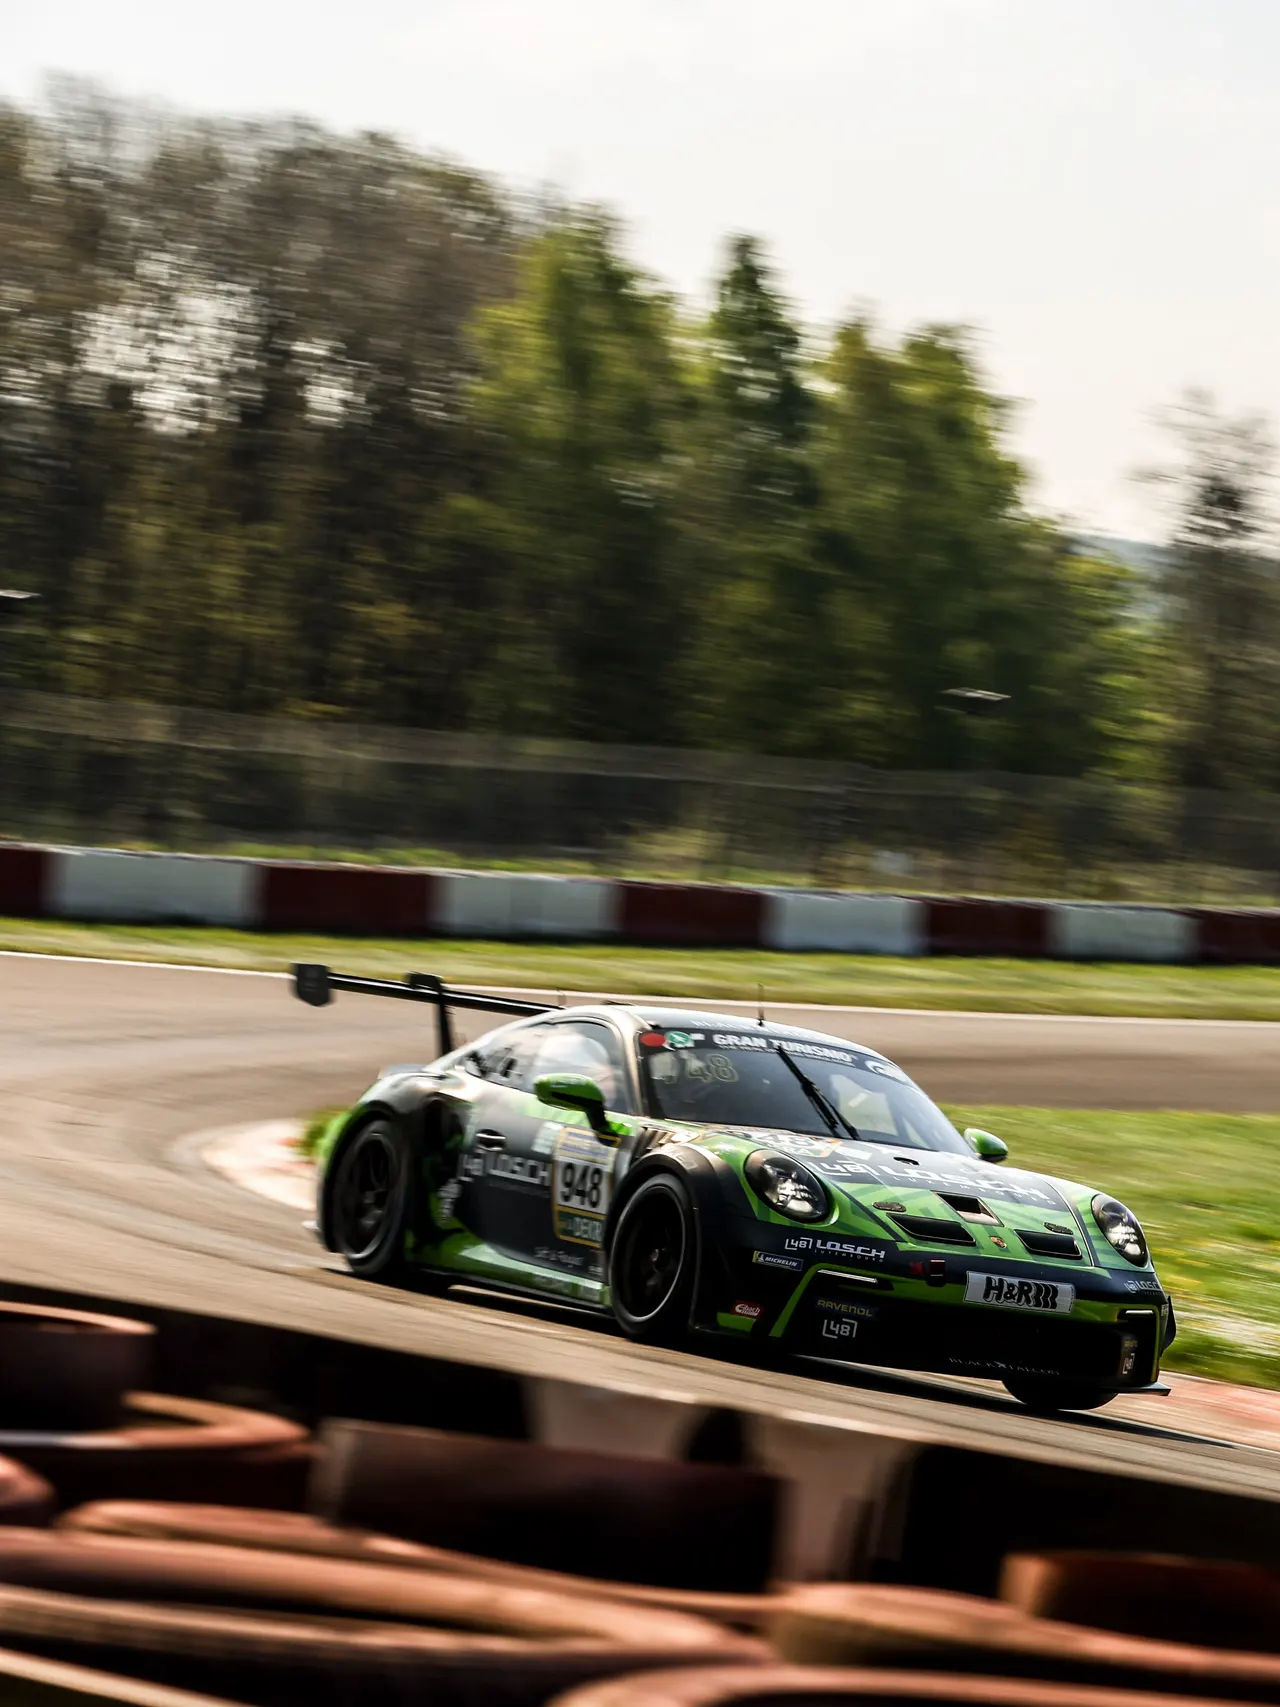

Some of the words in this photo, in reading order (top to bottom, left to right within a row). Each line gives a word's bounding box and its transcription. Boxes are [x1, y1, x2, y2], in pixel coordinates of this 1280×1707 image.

[713, 1033, 767, 1049] GRAN
[769, 1038, 852, 1063] TURISMO
[560, 1161, 604, 1209] 948
[815, 1239, 886, 1259] LOSCH
[764, 1256, 798, 1267] MICHELIN
[1134, 1280, 1162, 1292] LOSC
[817, 1299, 874, 1317] RAVENOL
